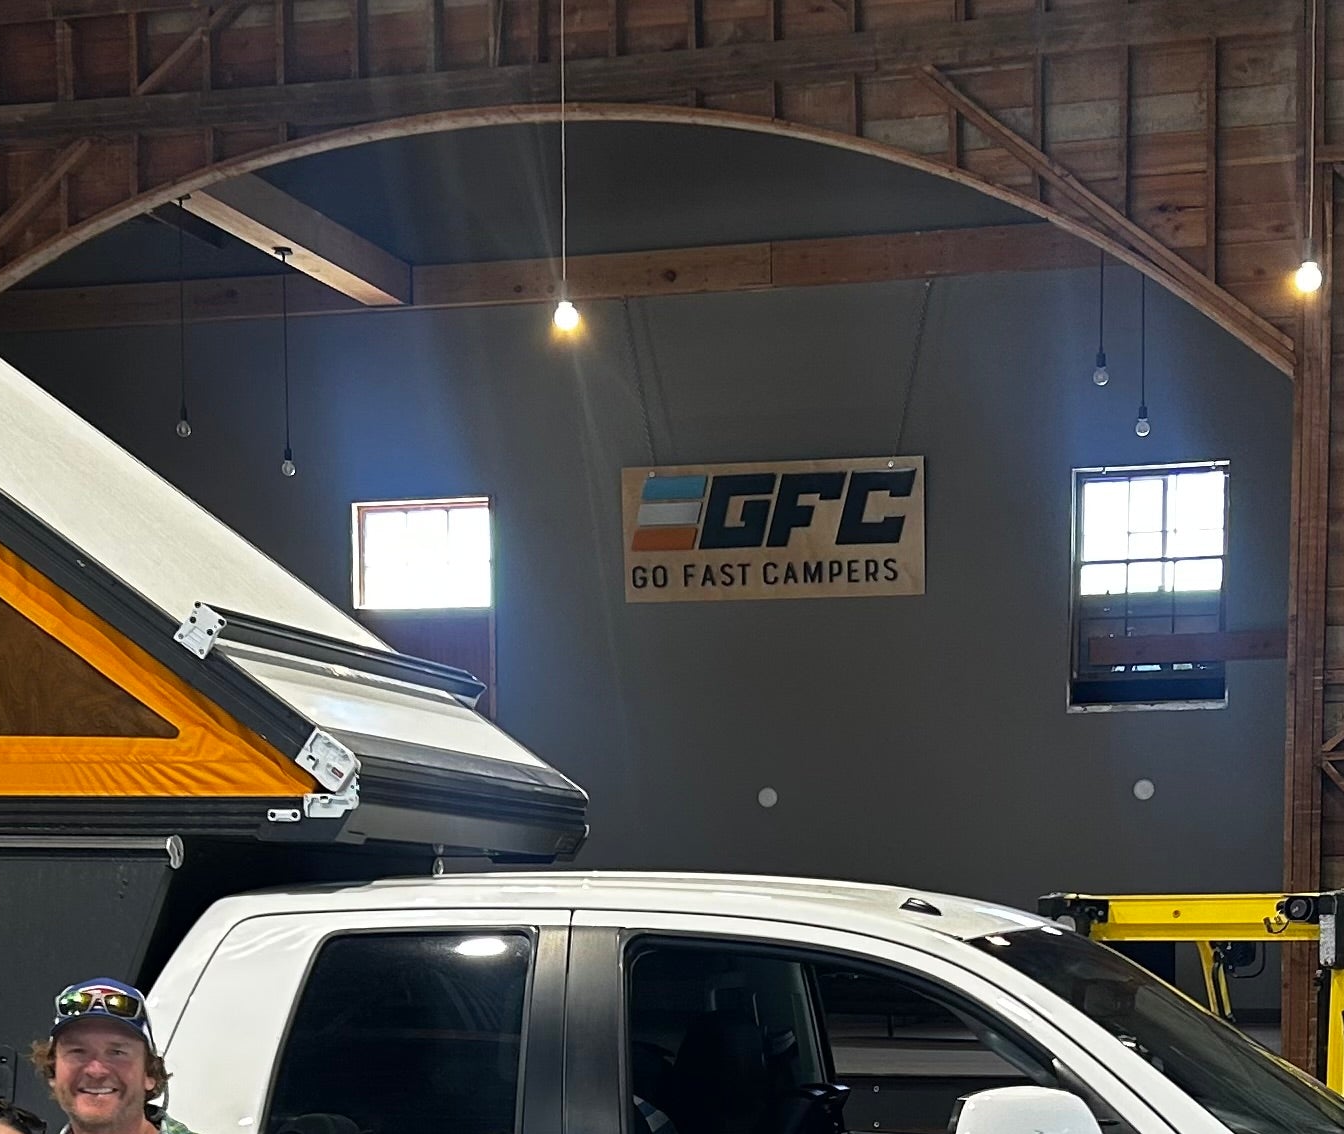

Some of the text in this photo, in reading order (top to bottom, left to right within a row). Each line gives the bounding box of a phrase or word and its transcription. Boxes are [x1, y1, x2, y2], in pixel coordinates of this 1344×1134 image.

[698, 468, 917, 550] GFC
[632, 558, 900, 589] GO FAST CAMPERS
